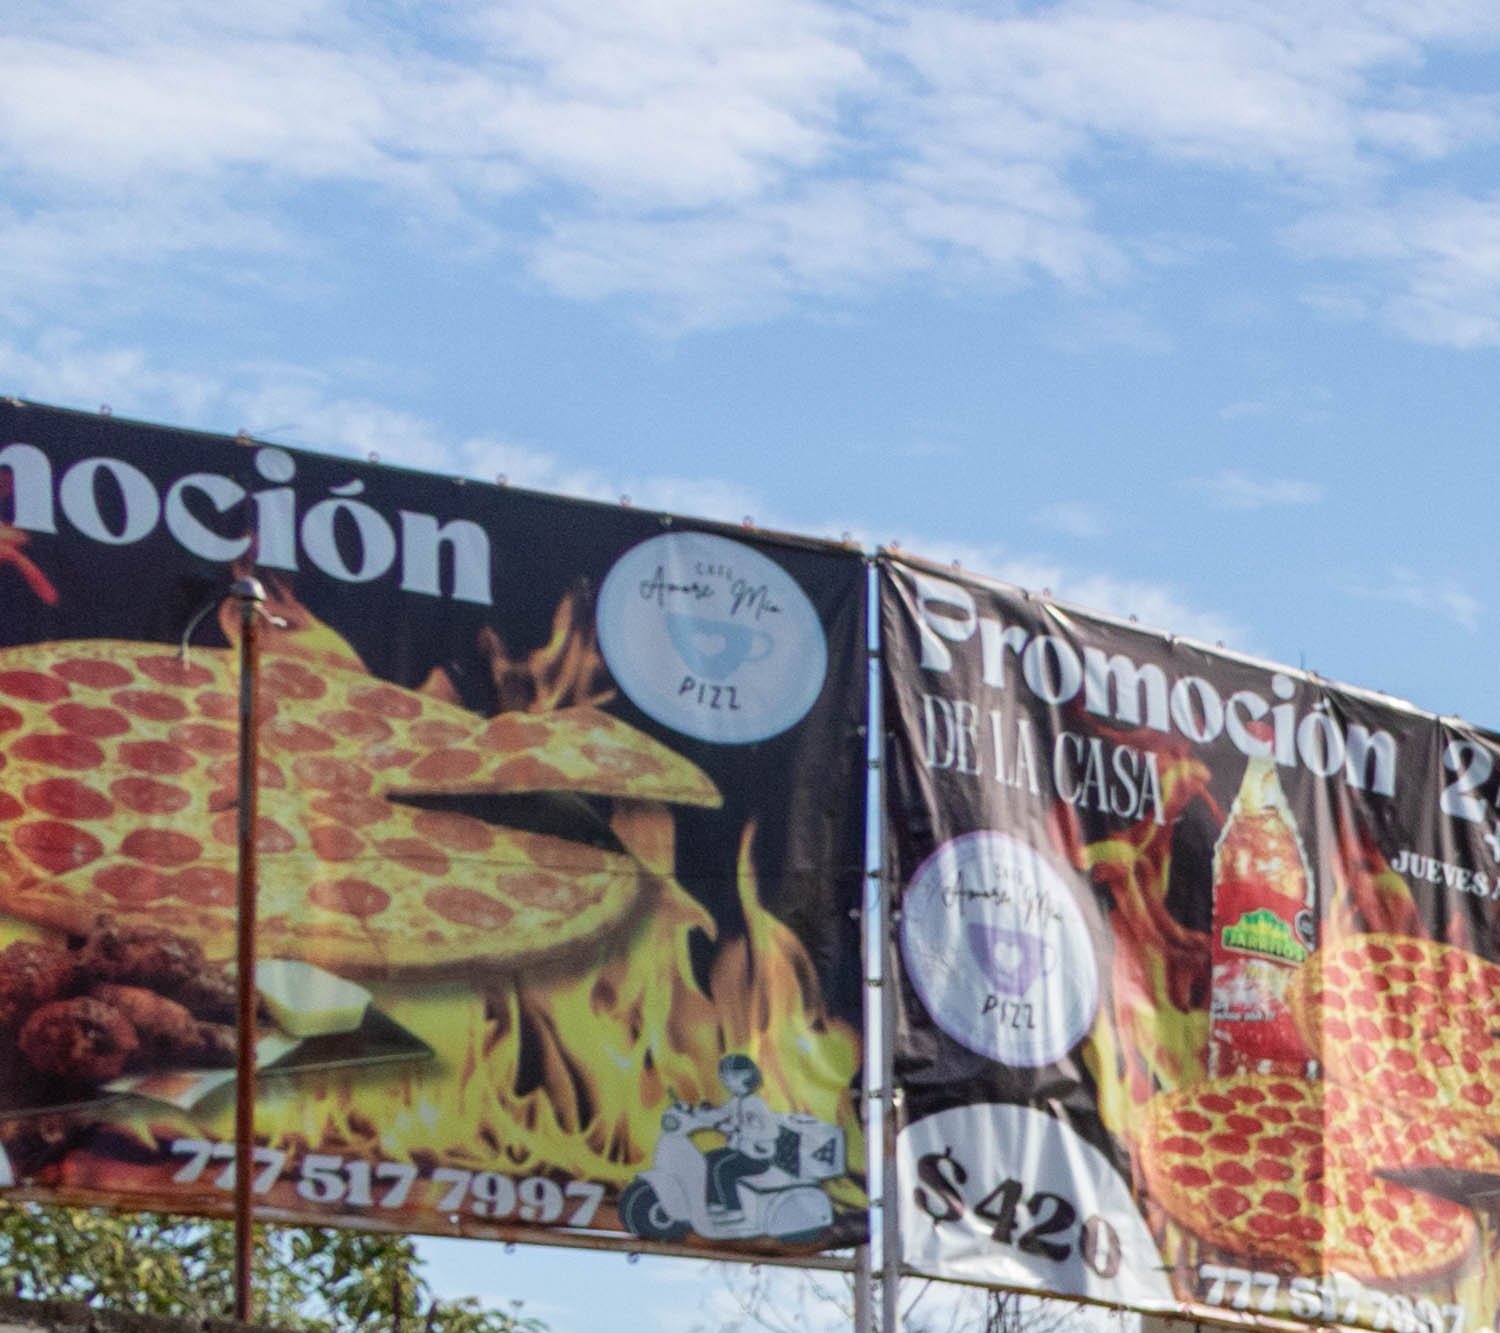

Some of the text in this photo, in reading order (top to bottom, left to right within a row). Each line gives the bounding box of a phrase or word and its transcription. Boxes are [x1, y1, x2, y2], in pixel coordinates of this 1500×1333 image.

[678, 675, 741, 710] PIZZ
[914, 573, 1397, 798] Promoción
[923, 694, 1165, 826] DE LA CASA
[1440, 739, 1494, 824] 2
[1391, 851, 1491, 898] JUEVES
[170, 1139, 606, 1228] 777 517 7997
[914, 1146, 1122, 1280] $420
[1199, 1263, 1280, 1313] 777
[1288, 1269, 1362, 1326] 517
